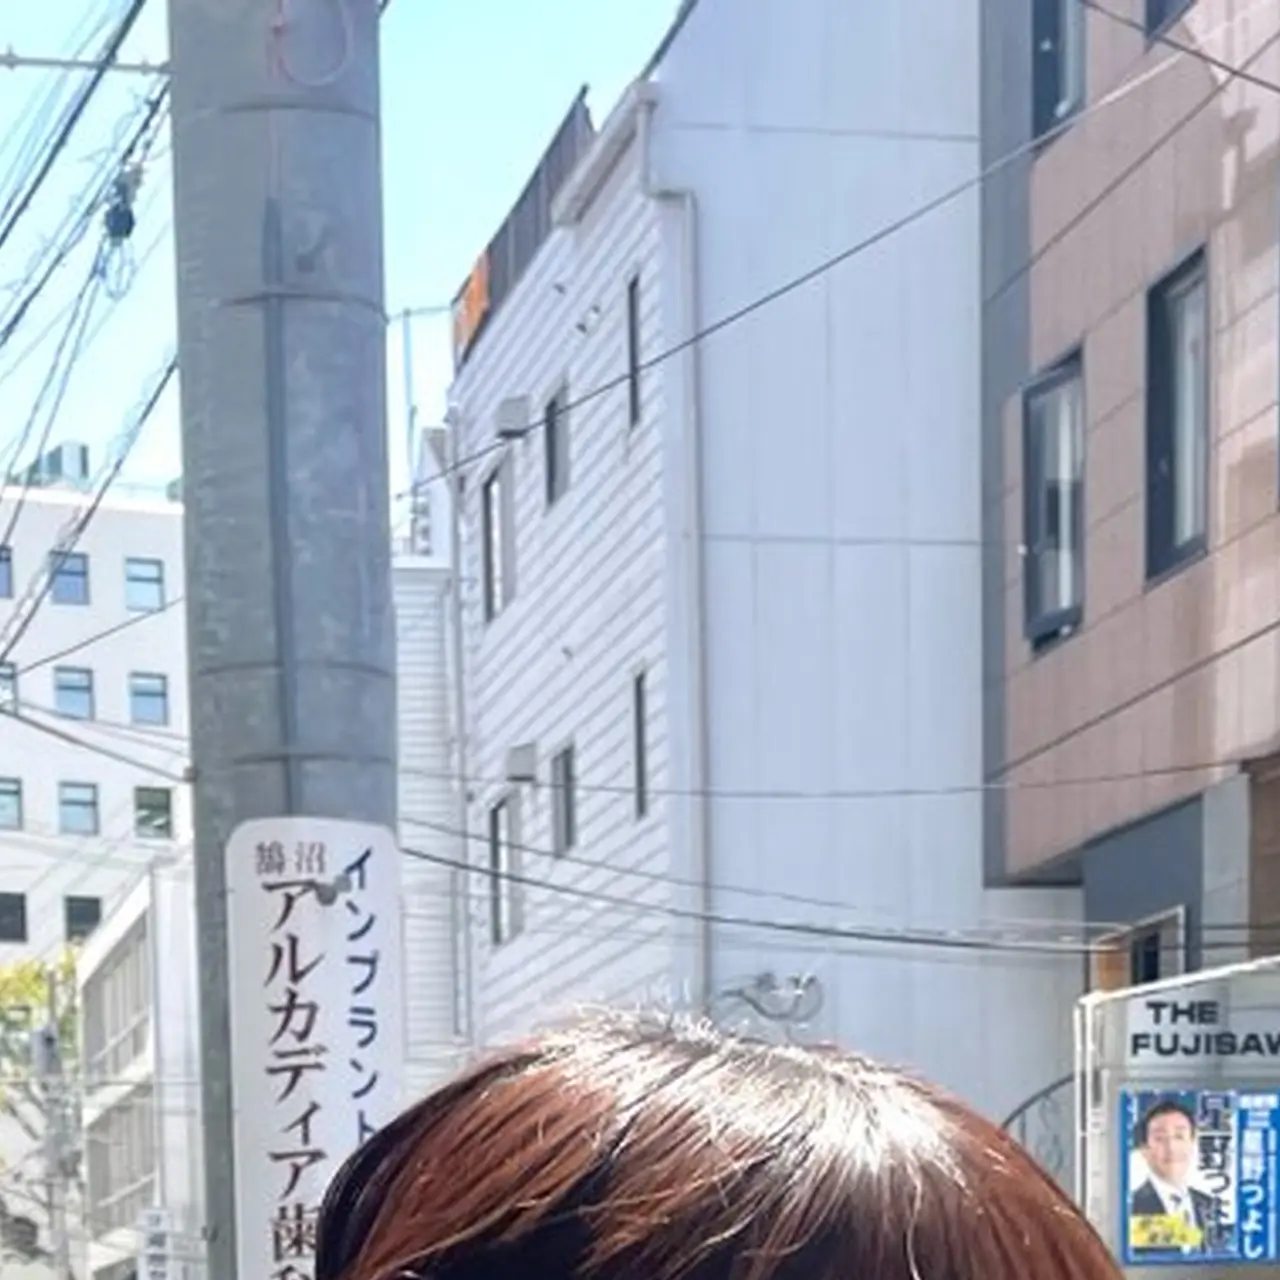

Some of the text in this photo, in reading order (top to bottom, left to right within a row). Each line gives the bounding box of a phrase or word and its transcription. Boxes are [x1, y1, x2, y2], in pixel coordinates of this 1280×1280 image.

[341, 848, 380, 1146] インプラント
[1146, 1001, 1218, 1025] THE
